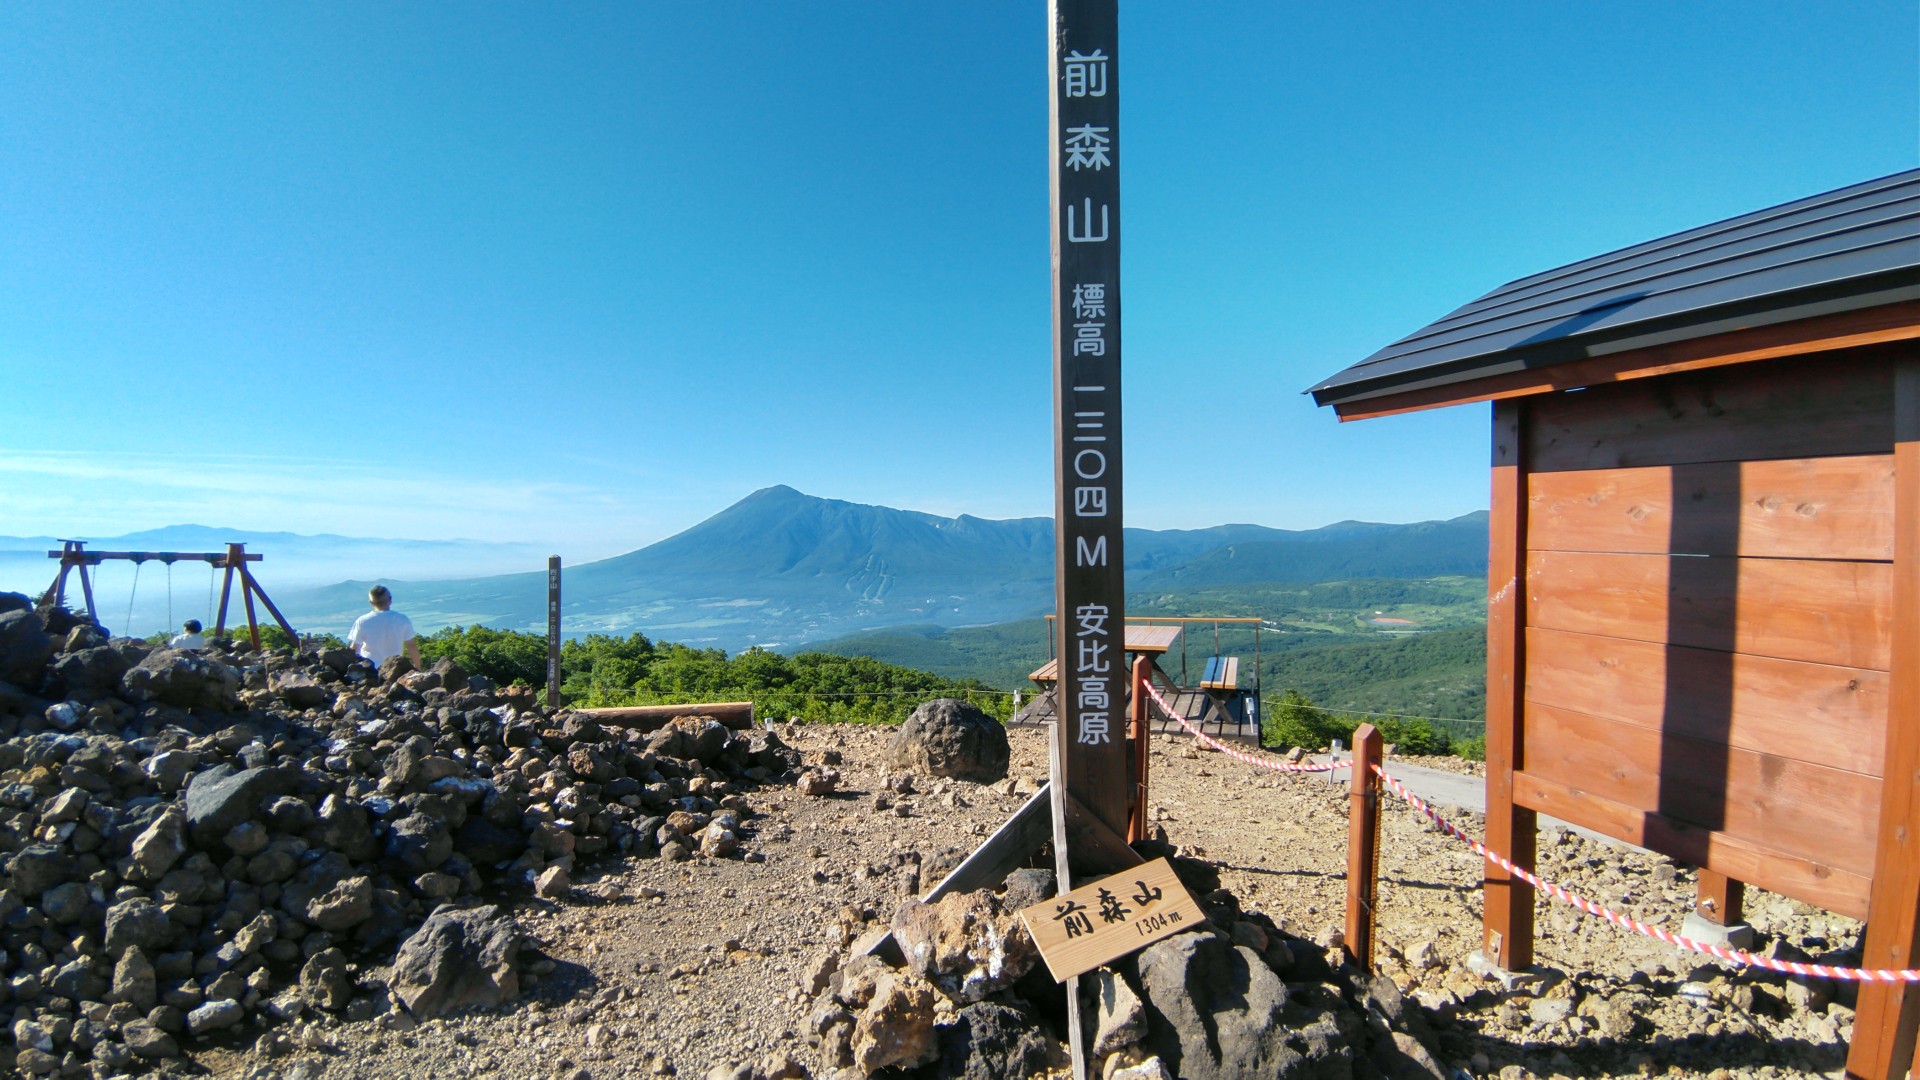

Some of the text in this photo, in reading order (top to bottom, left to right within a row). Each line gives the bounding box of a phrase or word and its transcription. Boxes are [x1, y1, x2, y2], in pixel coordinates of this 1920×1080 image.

[1063, 48, 1111, 243] 前森山
[1076, 602, 1111, 746] 安比高原
[1053, 881, 1162, 938] 前森山
